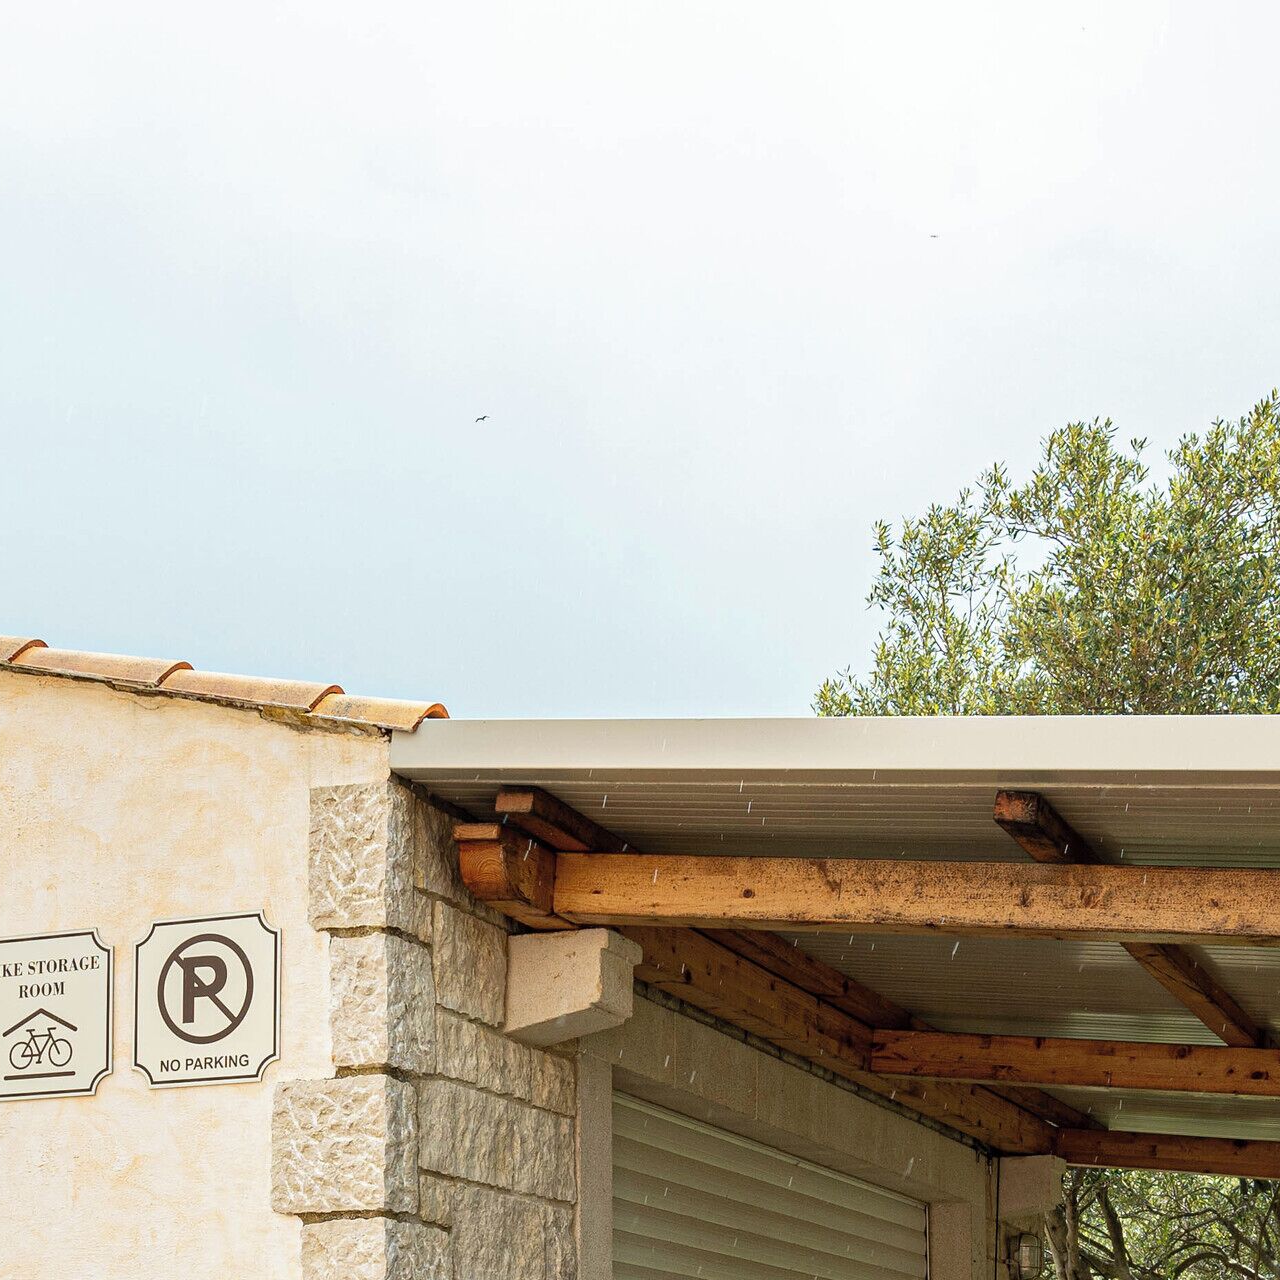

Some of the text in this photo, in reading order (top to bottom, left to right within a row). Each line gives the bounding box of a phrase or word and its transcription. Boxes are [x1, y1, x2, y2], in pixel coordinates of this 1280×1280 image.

[27, 955, 100, 976] STORAGE
[18, 981, 65, 999] ROOM
[160, 1054, 249, 1073] NO PARKING
